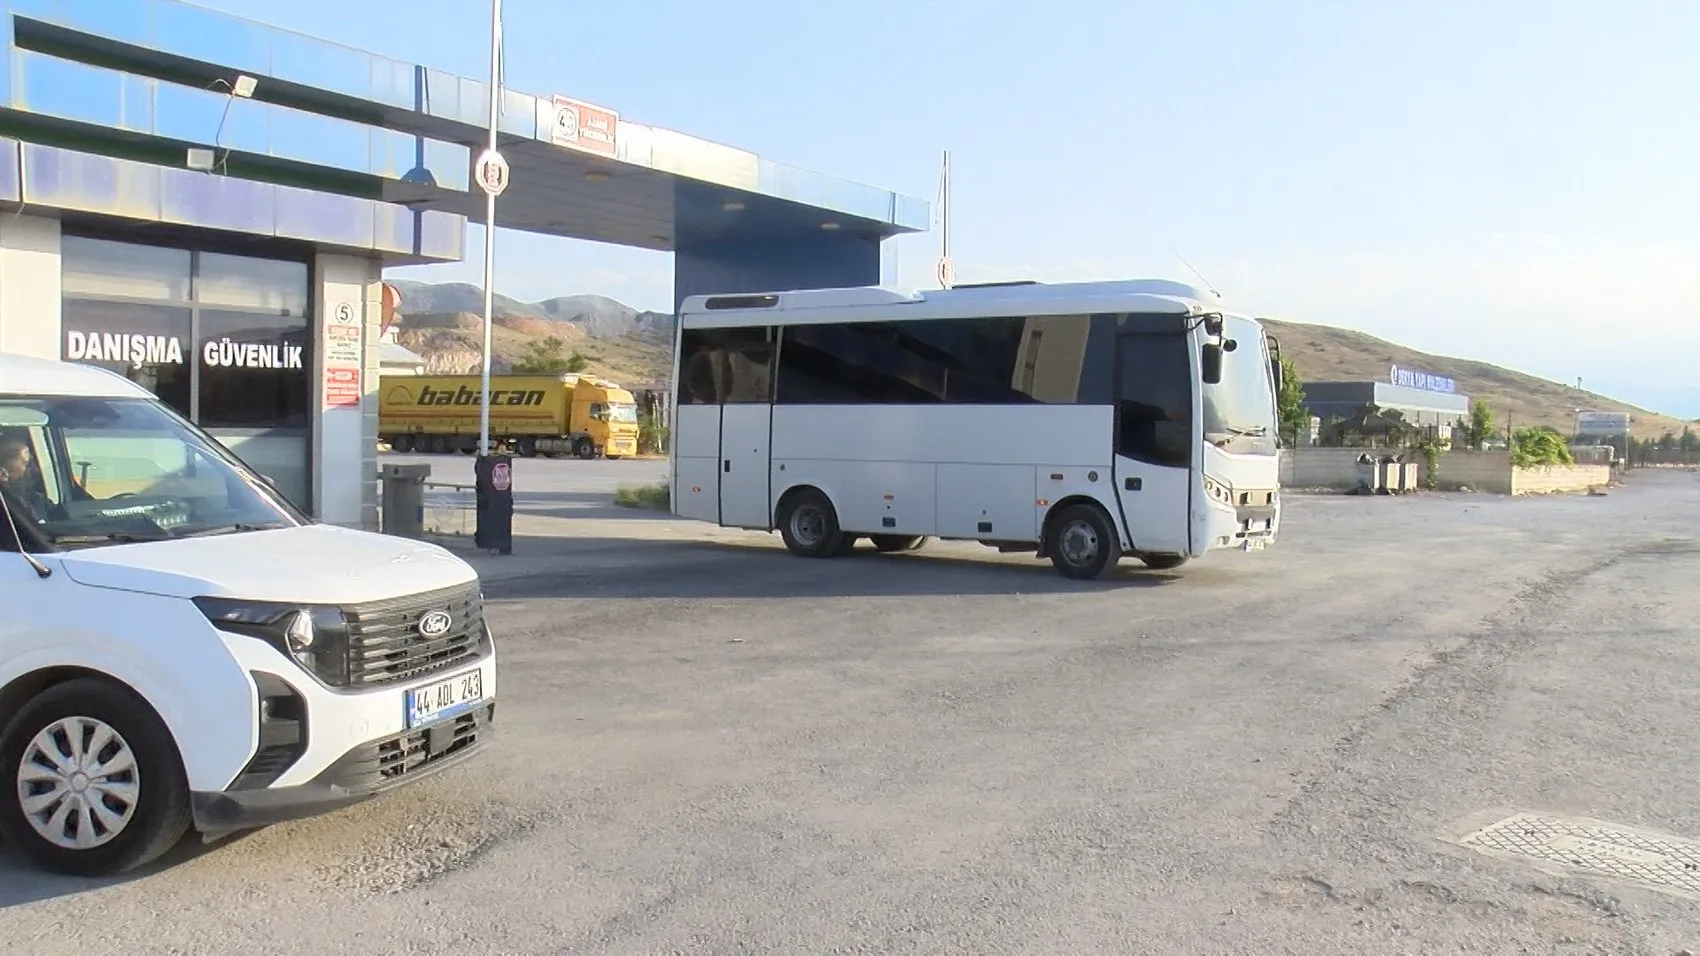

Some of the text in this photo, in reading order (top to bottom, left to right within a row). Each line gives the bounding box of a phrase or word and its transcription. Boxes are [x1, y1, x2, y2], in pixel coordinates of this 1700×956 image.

[340, 305, 349, 321] 5
[68, 331, 303, 370] DANIŞMA GÜVENLİK
[417, 385, 547, 406] babacan
[426, 611, 447, 632] Ford
[417, 691, 430, 715] 44
[462, 674, 479, 700] 243
